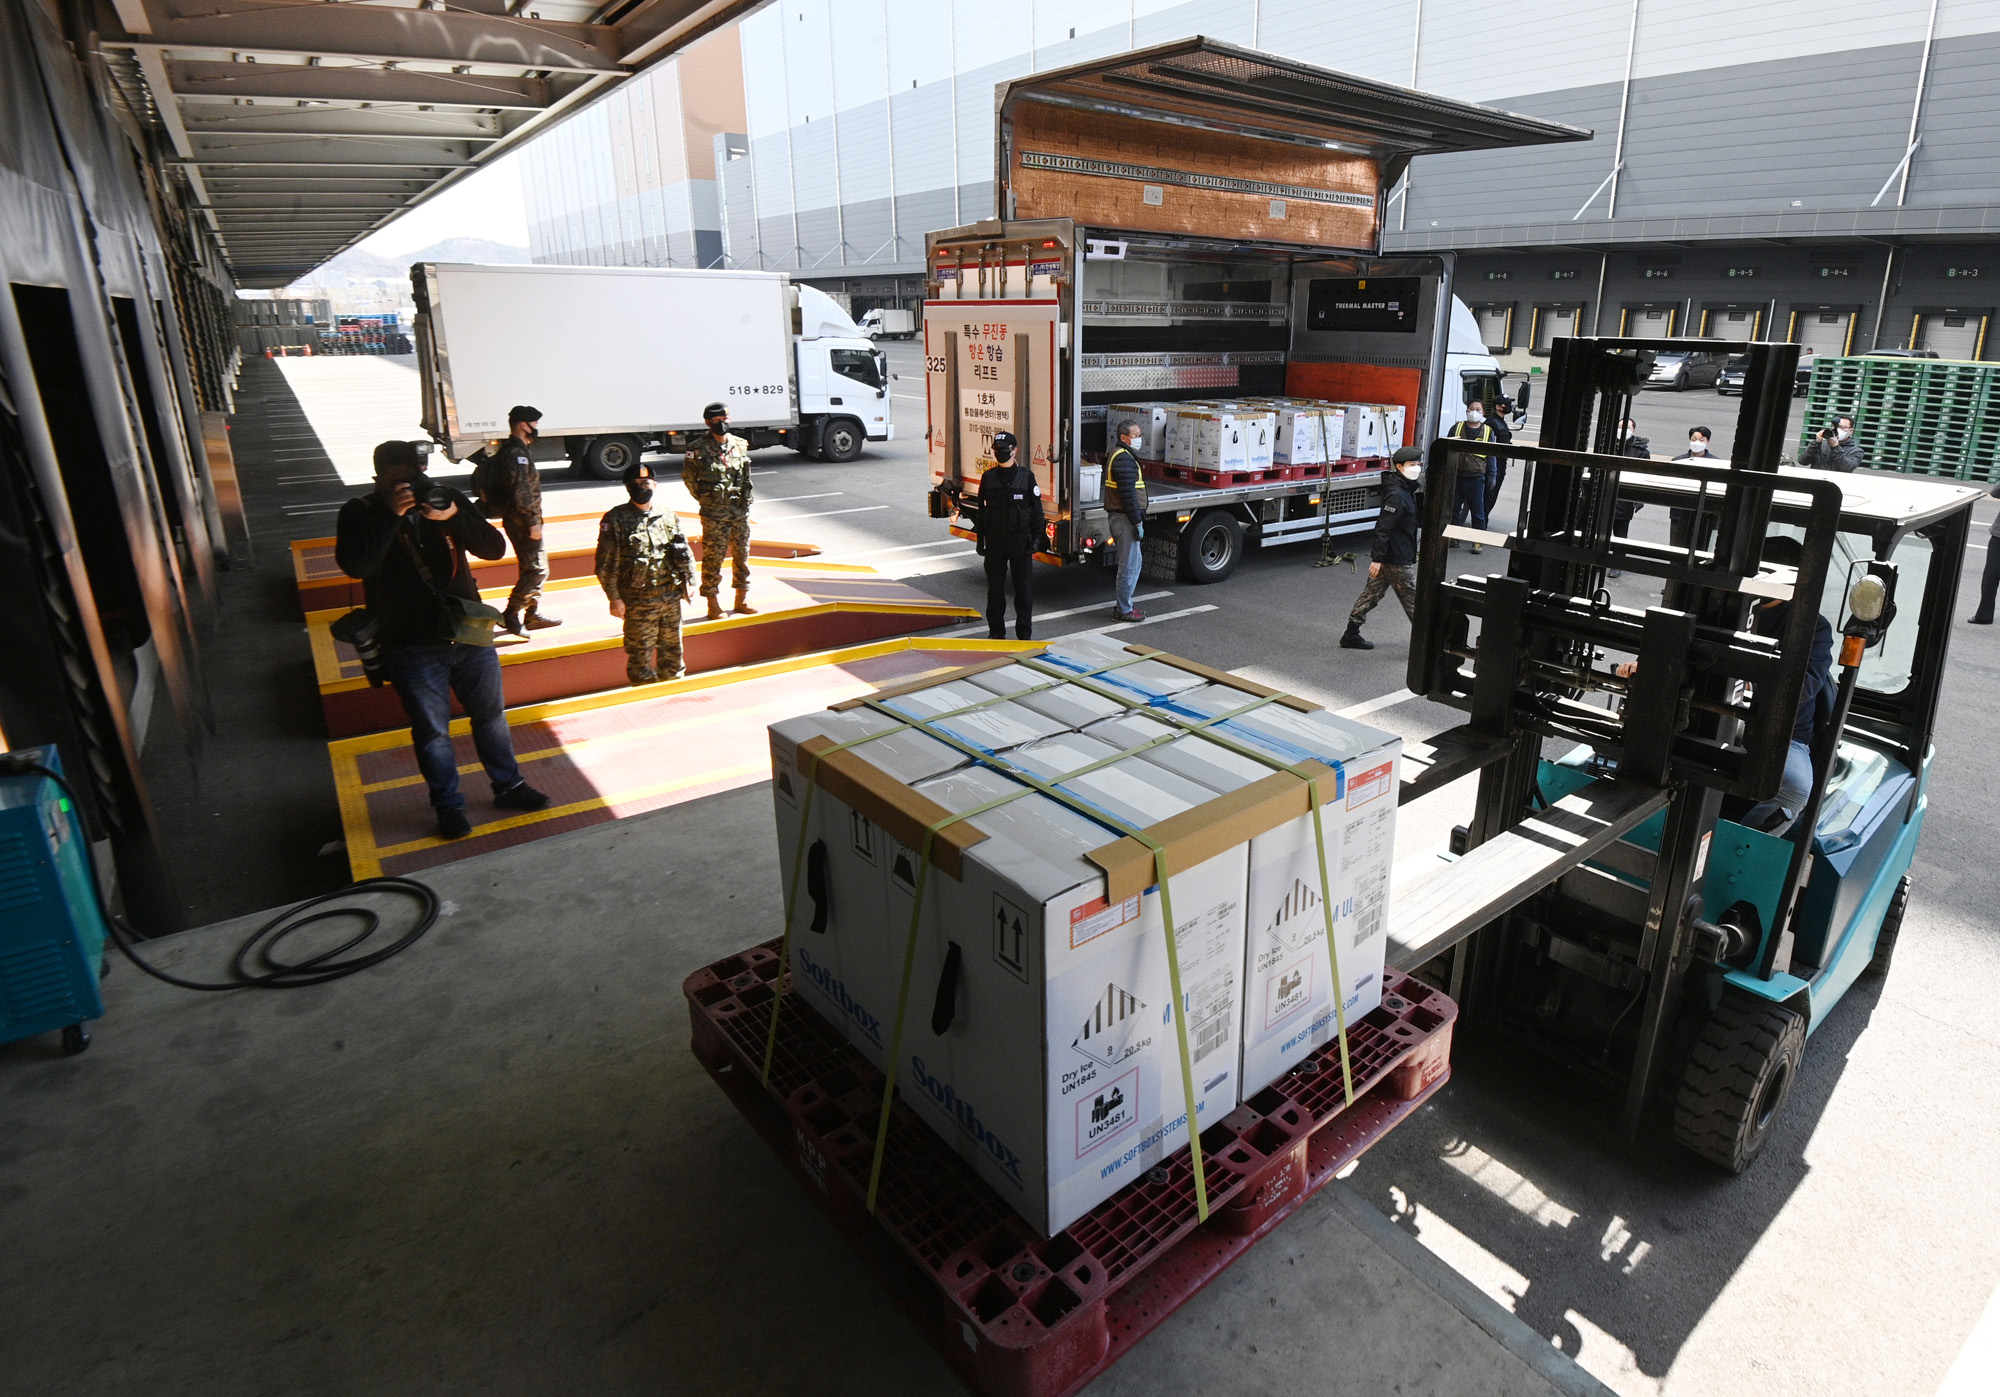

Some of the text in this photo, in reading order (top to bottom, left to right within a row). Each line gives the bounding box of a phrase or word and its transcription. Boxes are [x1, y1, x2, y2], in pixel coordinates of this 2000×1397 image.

[1821, 268, 1848, 277] B-B-4
[1947, 268, 1979, 277] B-B-3
[1335, 302, 1386, 310] THERMAL MASTER
[964, 323, 1007, 341] 특수 무진동
[968, 344, 1003, 362] 항온 항습
[926, 356, 946, 373] 325
[974, 364, 998, 380] 리프트
[977, 392, 996, 406] 1호차
[1258, 945, 1281, 962] Dry Ice
[1258, 952, 1284, 973] UN1845
[799, 947, 883, 1042] Softbox
[1275, 990, 1303, 1013] UN3481
[1280, 993, 1359, 1054] WWW.SOFTBOXSYSTES.COM
[1062, 1061, 1094, 1083] Dry Ice
[1062, 1069, 1097, 1095] UN1845
[911, 1055, 1024, 1179] Softbox
[1089, 1110, 1126, 1138] UN3481
